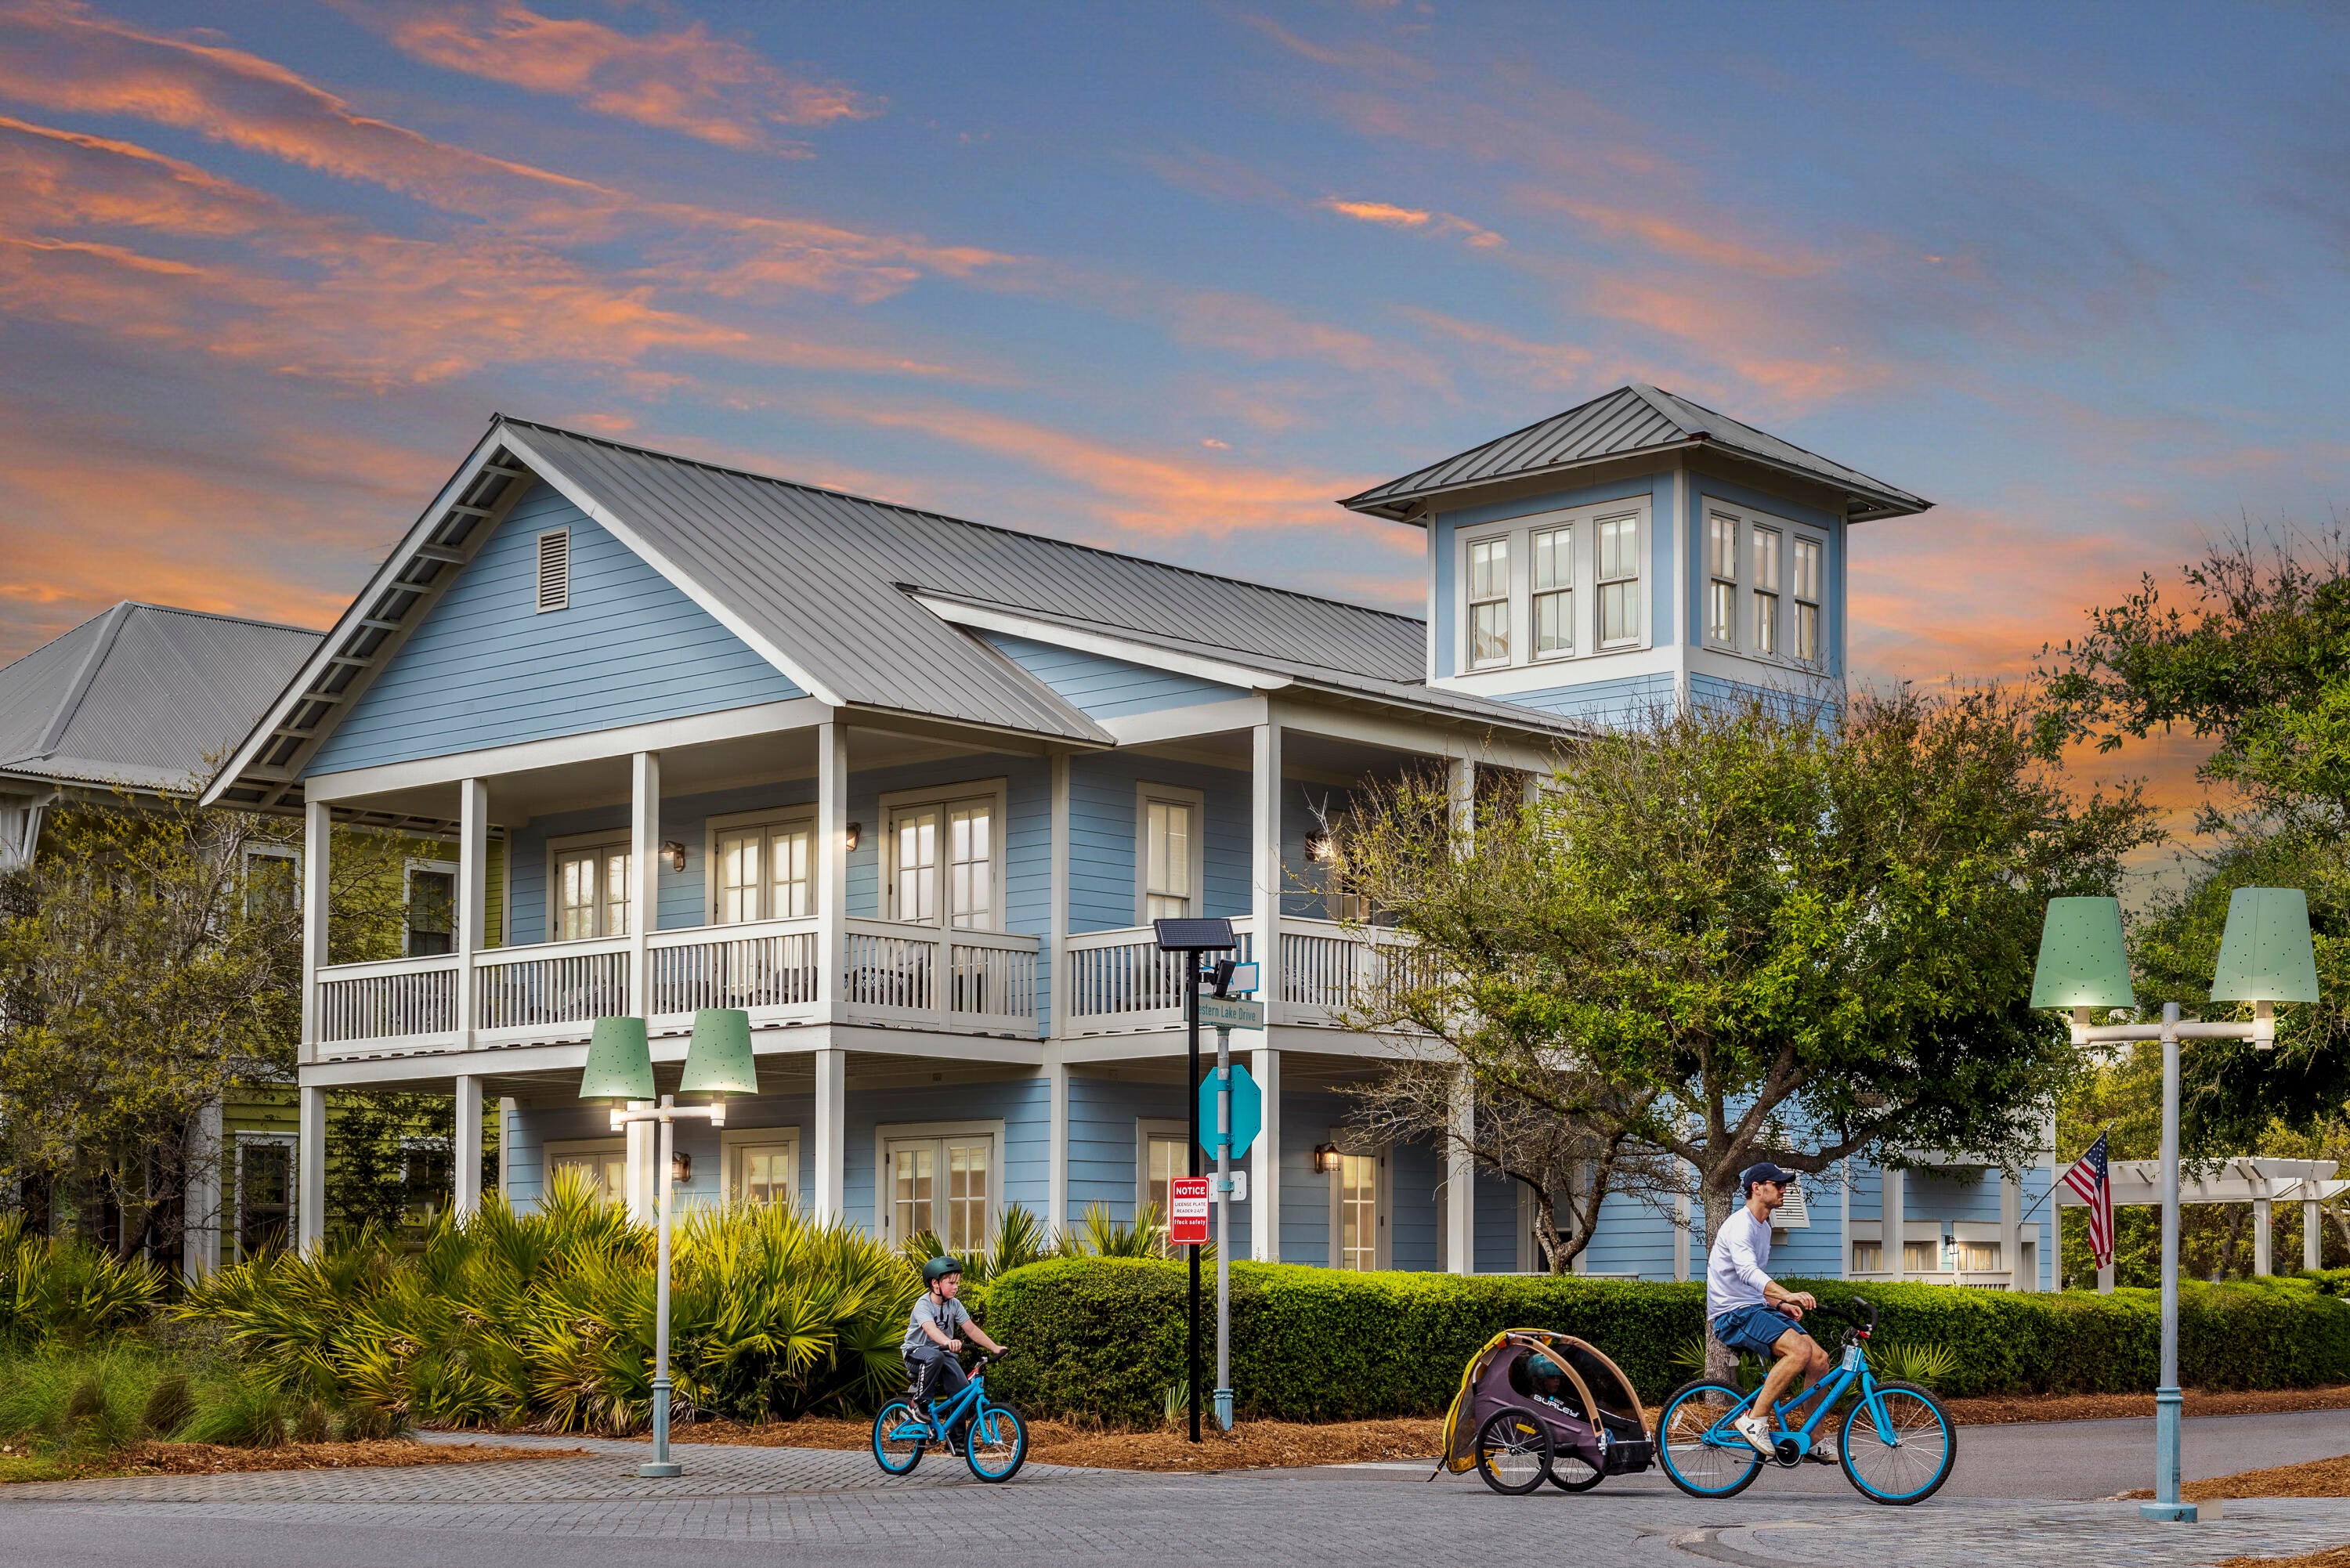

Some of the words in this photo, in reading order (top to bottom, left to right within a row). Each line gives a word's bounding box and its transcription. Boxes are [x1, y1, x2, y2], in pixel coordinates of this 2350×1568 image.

[1198, 1004, 1219, 1017] estern
[1221, 1006, 1237, 1019] Lake
[1238, 1007, 1256, 1021] Drive
[1176, 1187, 1206, 1195] NOTICE
[1534, 1394, 1578, 1418] BURLEY
